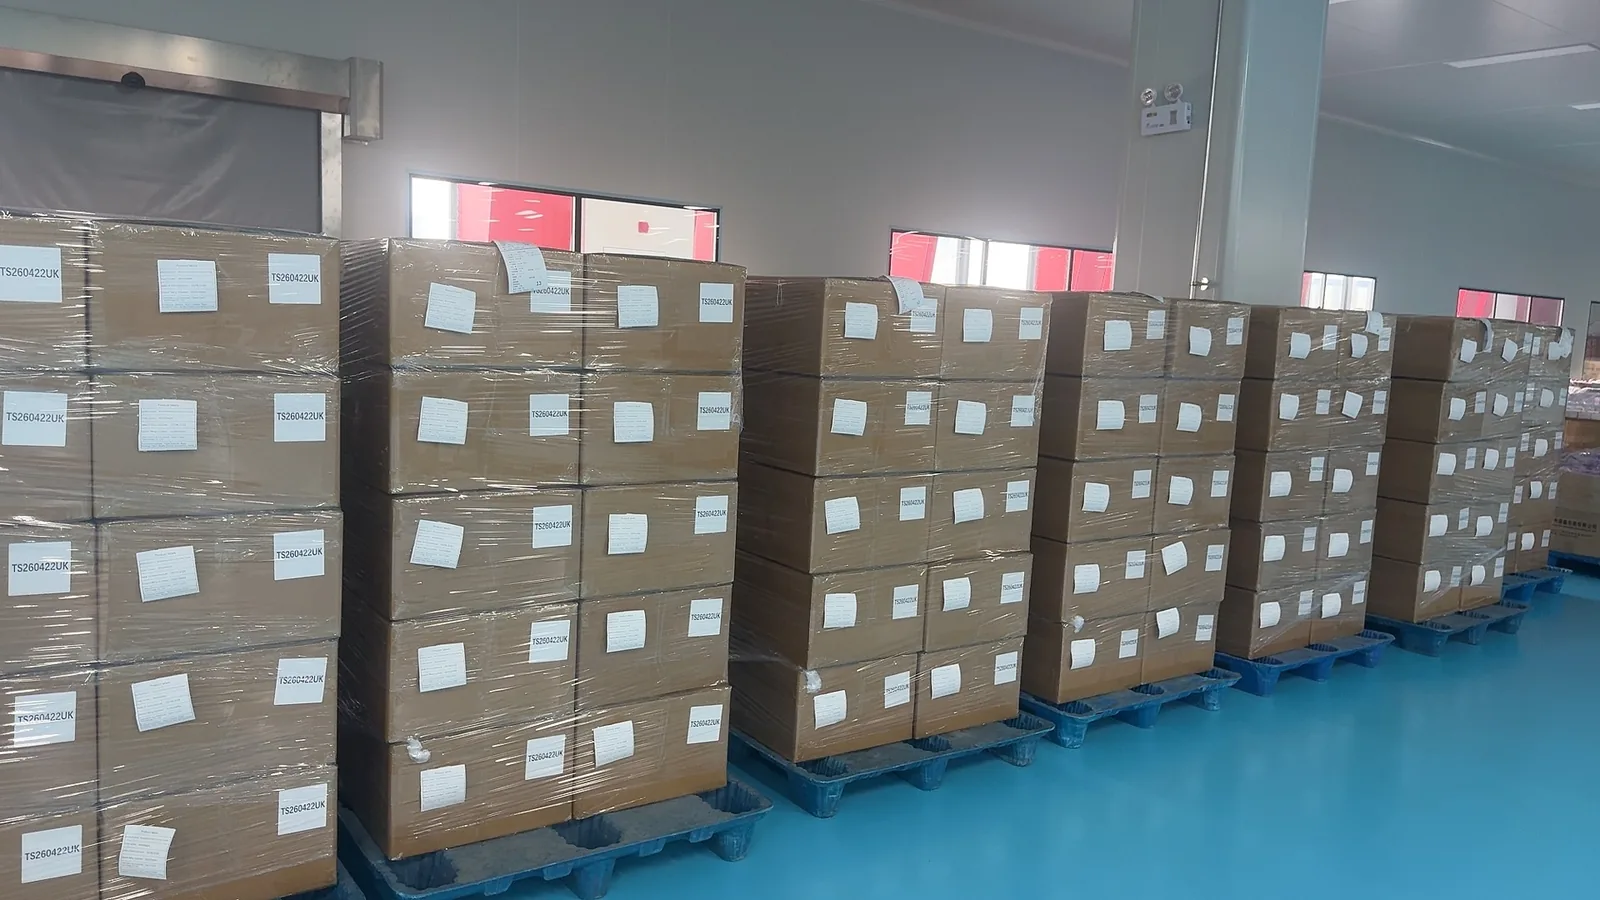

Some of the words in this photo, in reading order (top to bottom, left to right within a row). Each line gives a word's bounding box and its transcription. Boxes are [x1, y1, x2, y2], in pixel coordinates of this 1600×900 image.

[0, 266, 60, 279] TS260422UK
[271, 272, 319, 283] TS260422UK
[701, 297, 733, 307] TS260422UK
[531, 409, 568, 419] TS260422UK
[699, 405, 730, 414] TS260422UK
[6, 411, 65, 423] TS260422UK
[276, 411, 324, 421] TS260422UK
[696, 509, 727, 519] TS260422UK
[534, 520, 571, 531] TS260422UK
[276, 547, 323, 560] TS260422UK
[11, 561, 69, 573] TS260422UK
[691, 611, 721, 622] TS260422UK
[532, 635, 568, 646] TS260422UK
[278, 674, 324, 686] TS260422UK
[690, 717, 720, 729] TS260422UK
[527, 749, 563, 764] TS260422UK
[280, 800, 326, 816] TS260422UK
[24, 844, 80, 861] TS260422UK
